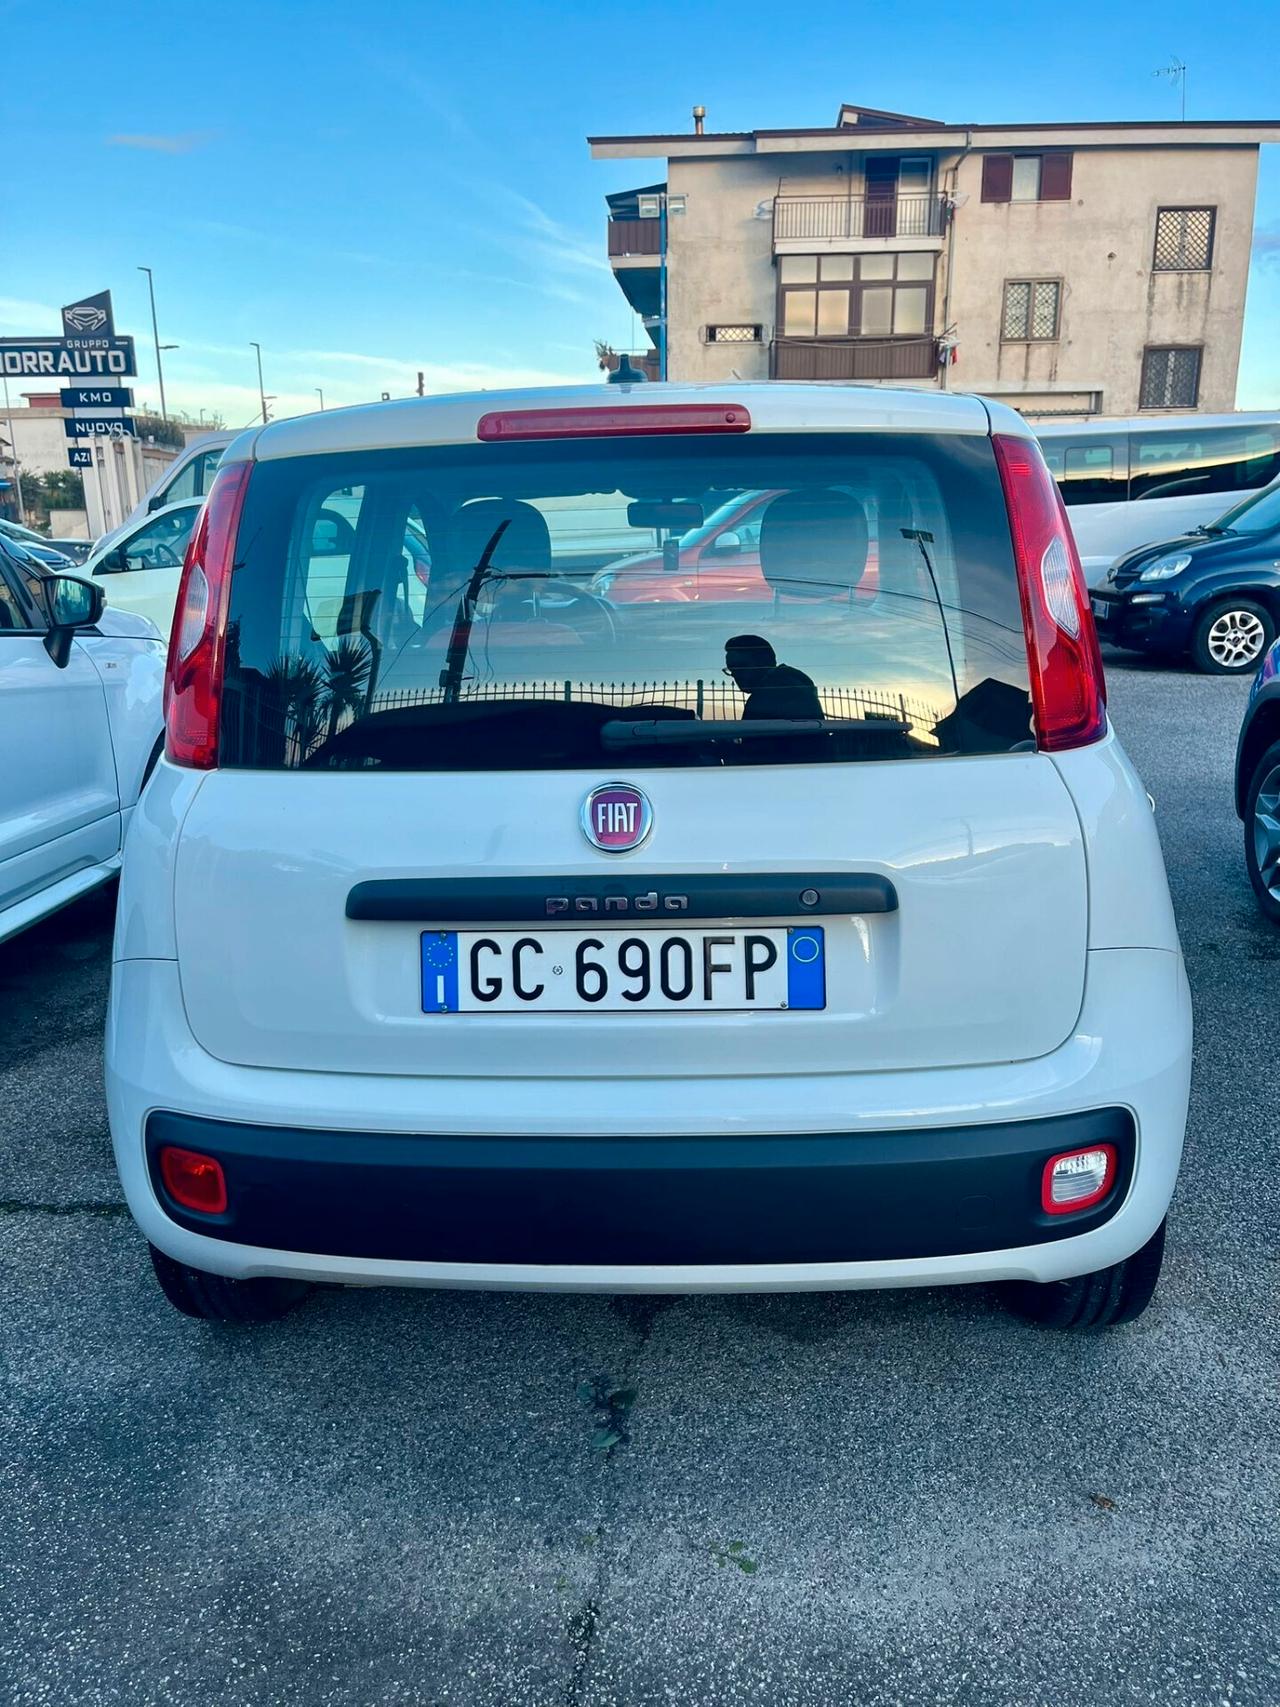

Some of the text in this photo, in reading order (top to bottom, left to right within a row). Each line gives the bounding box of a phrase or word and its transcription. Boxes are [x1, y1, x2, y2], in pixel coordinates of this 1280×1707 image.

[66, 339, 109, 349] GRUPPO
[0, 350, 126, 374] ORRAUTO
[75, 422, 123, 433] NUOVO
[597, 803, 638, 833] FIAT
[546, 892, 688, 915] panda
